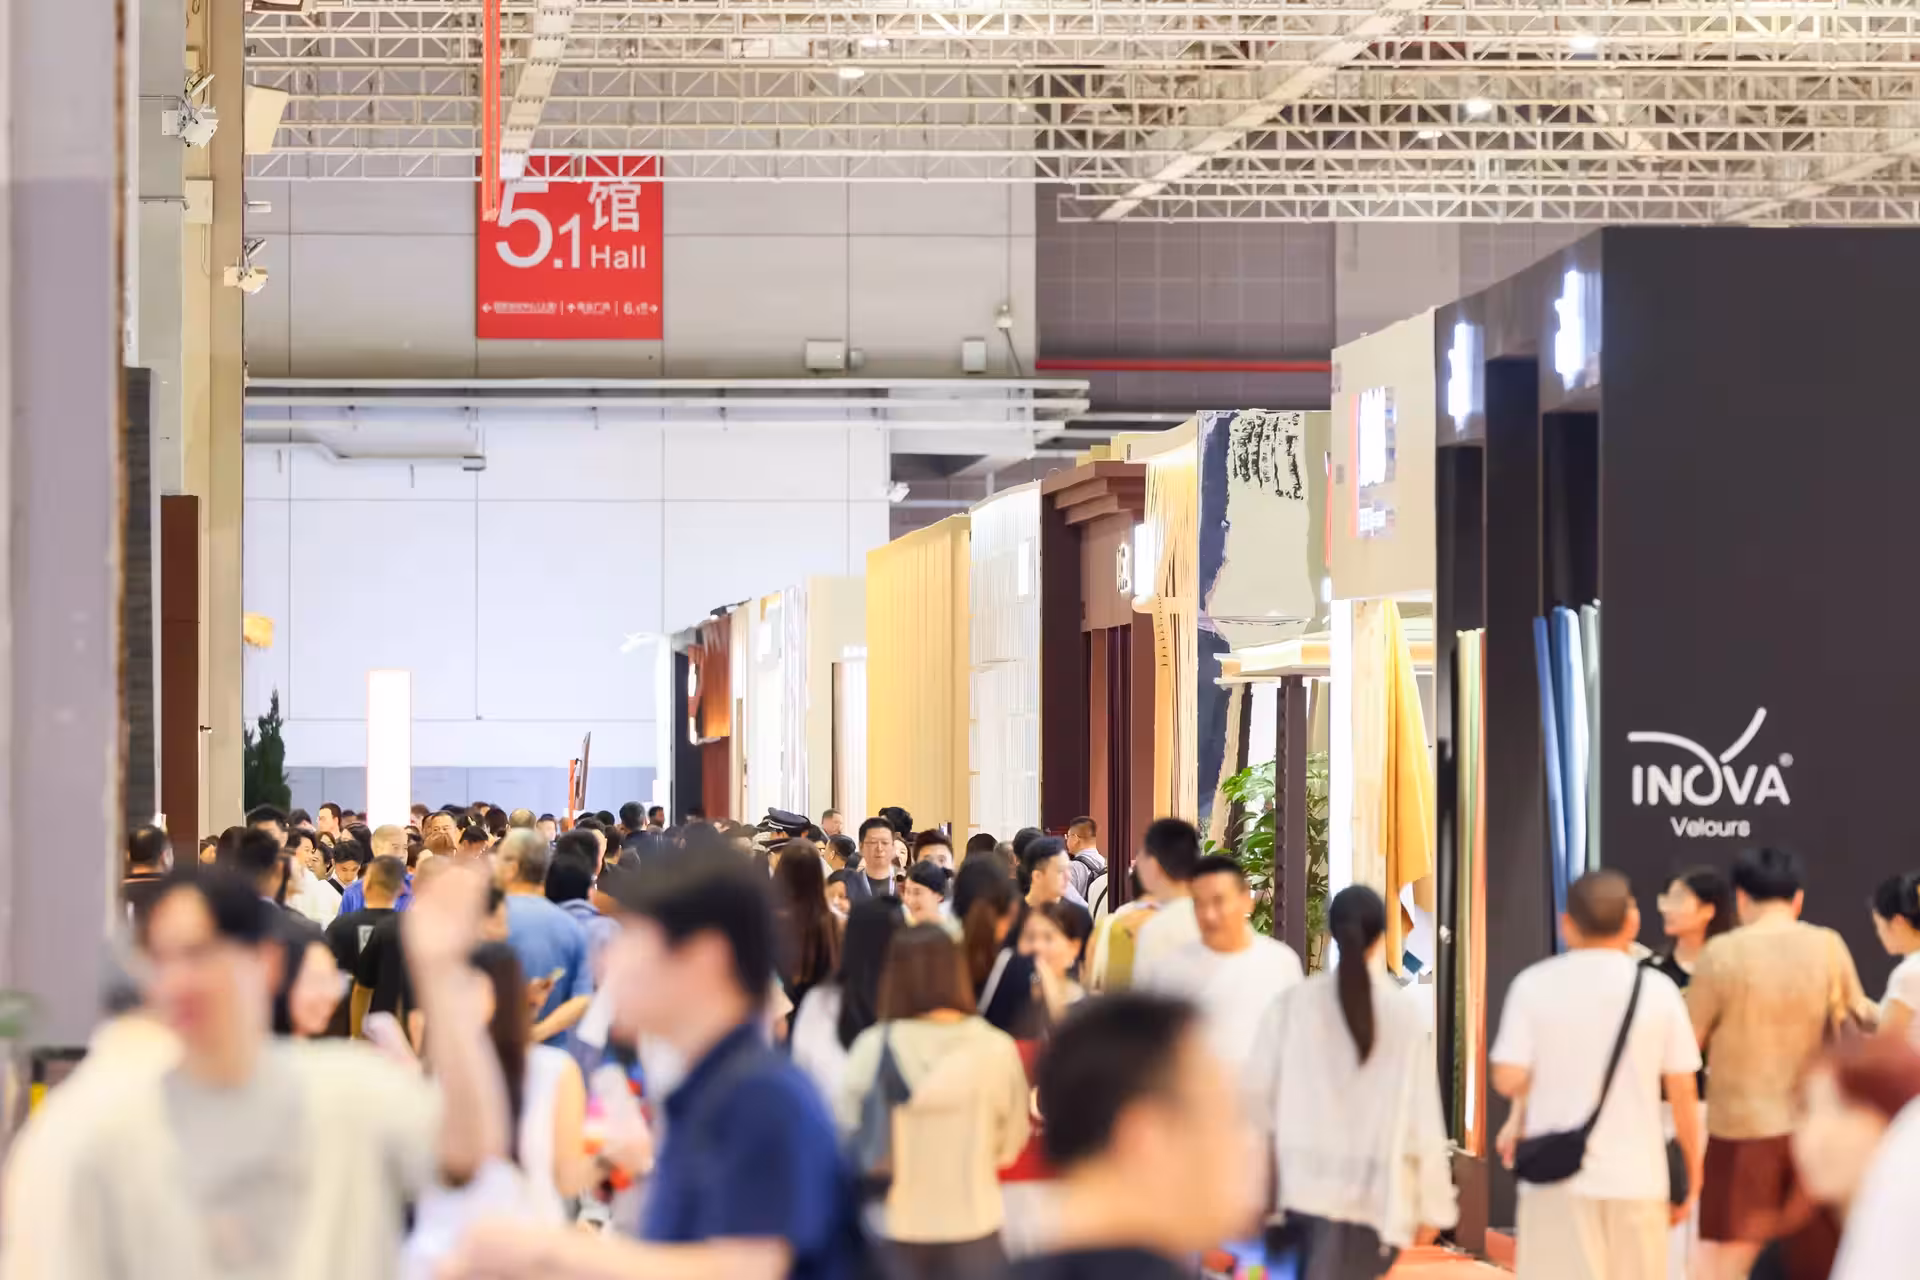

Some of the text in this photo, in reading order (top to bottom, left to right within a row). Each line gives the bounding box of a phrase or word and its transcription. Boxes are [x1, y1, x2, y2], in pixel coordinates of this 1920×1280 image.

[495, 180, 642, 268] 5.1 馆
[590, 244, 646, 269] Hall
[1628, 731, 1791, 806] INOVA
[1670, 816, 1751, 838] Velours
